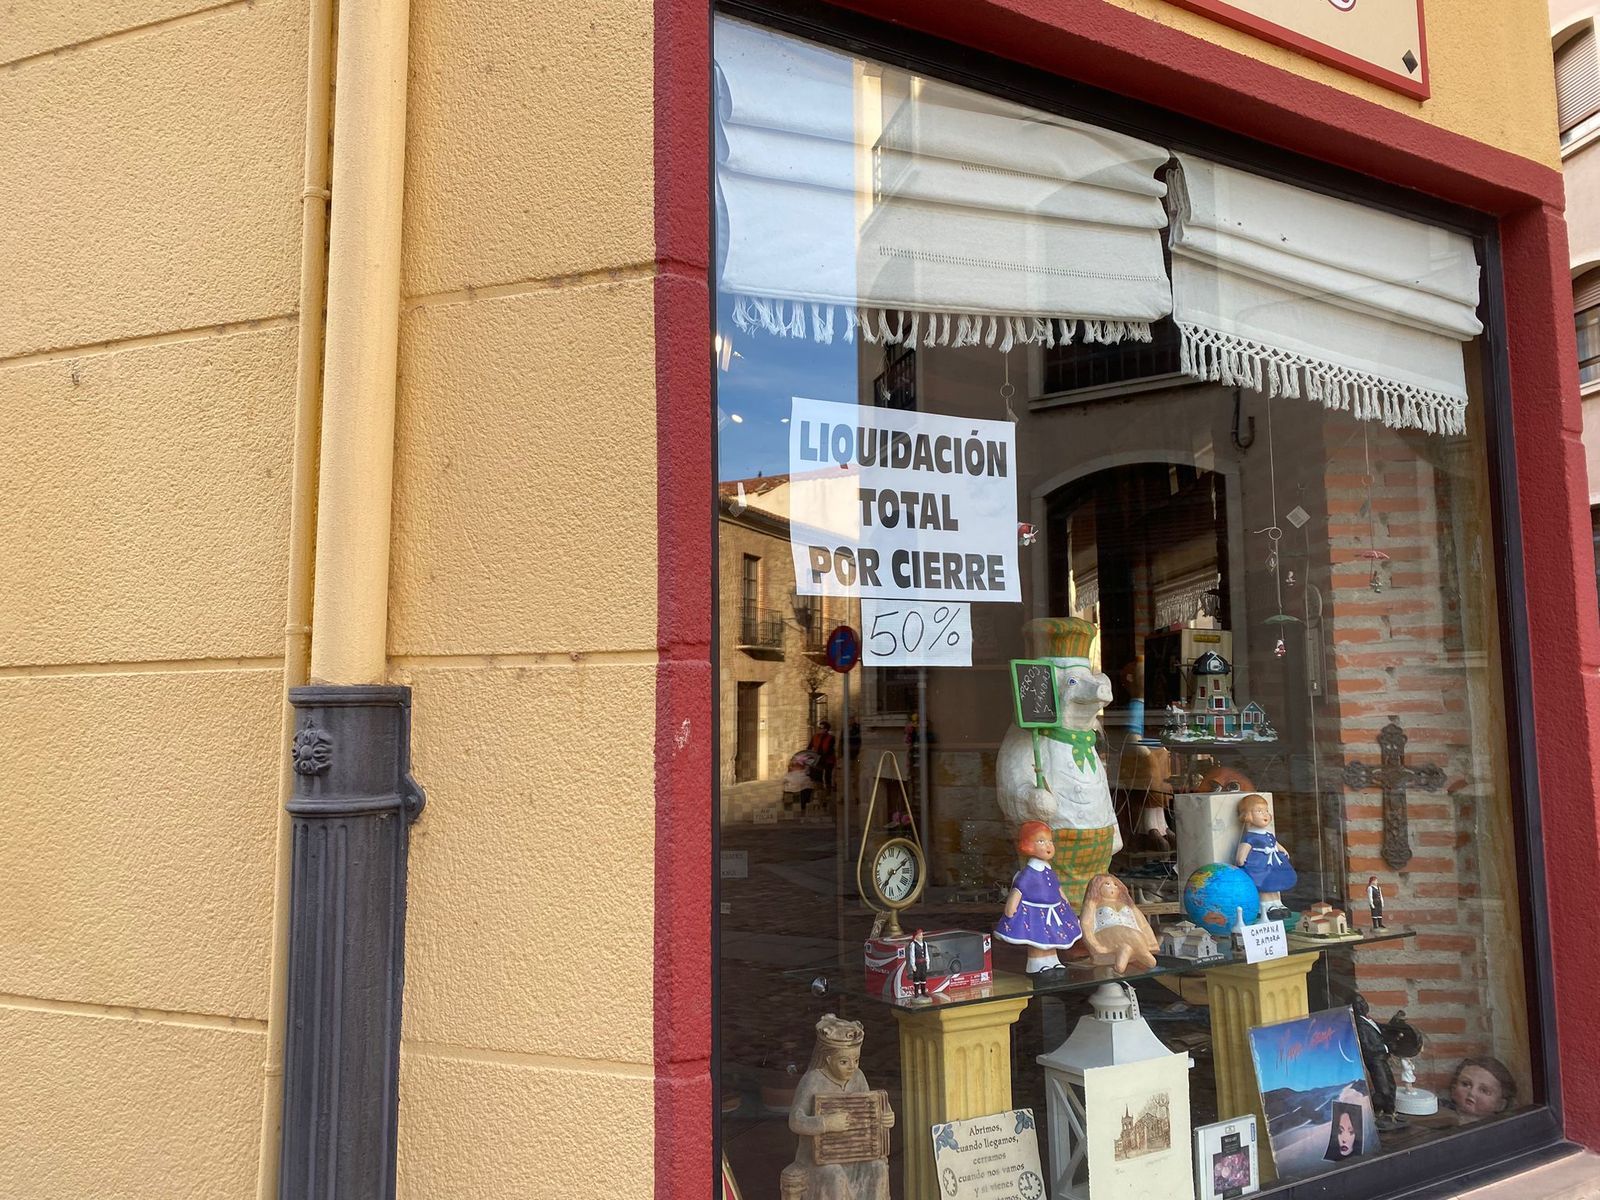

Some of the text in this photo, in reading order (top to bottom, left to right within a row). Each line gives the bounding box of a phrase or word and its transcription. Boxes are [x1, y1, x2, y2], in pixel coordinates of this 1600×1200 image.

[800, 420, 1007, 478] LIQUIDACIÓN
[858, 488, 959, 532] TOTAL
[808, 545, 1006, 591] POR CIERRE
[869, 606, 961, 657] 50%
